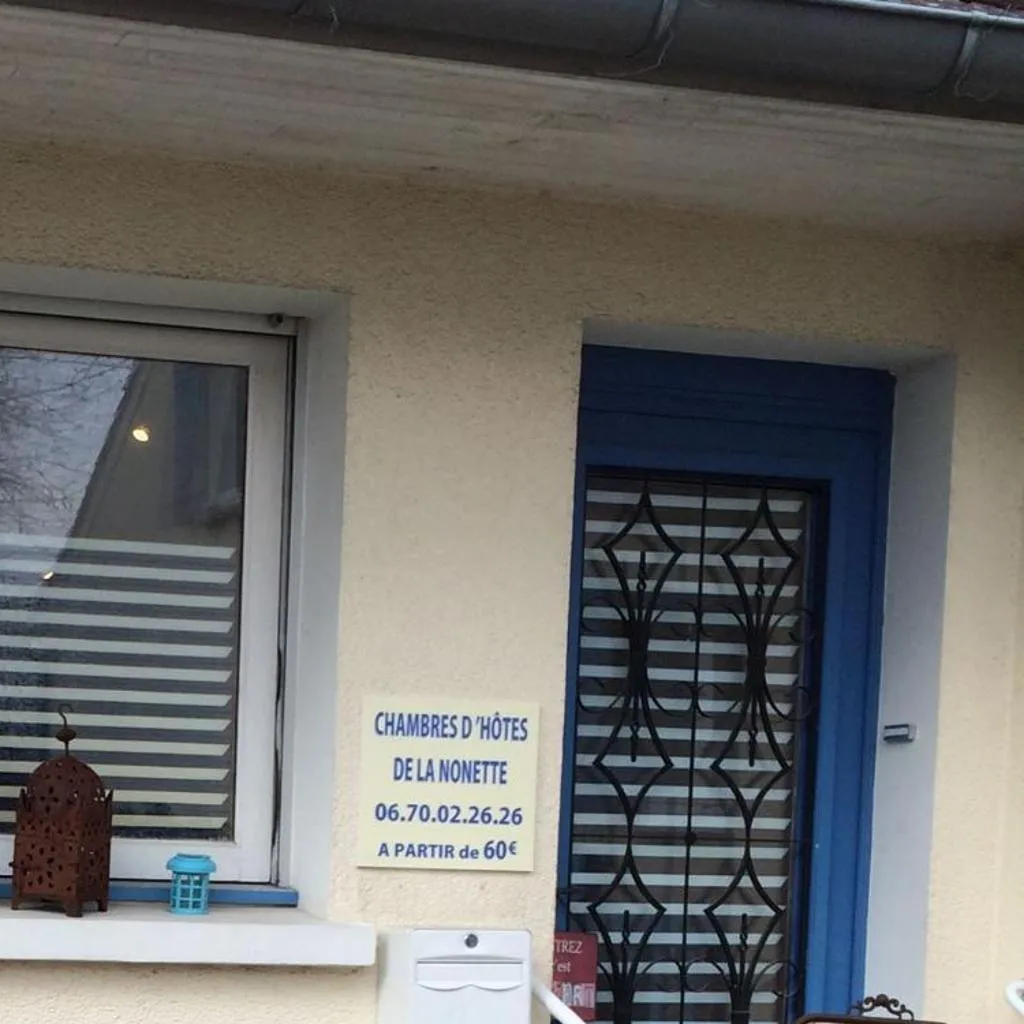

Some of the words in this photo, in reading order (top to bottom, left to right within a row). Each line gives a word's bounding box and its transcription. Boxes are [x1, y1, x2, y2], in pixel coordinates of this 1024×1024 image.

[375, 711, 458, 740] CHAMBRES
[393, 756, 413, 781] DE
[417, 758, 435, 782] LA
[439, 759, 508, 785] NONETTE
[375, 803, 524, 826] 06.70.02.26.26
[378, 842, 390, 857] A
[394, 843, 456, 859] PARTIR
[459, 844, 480, 860] de
[484, 839, 518, 861] 60€
